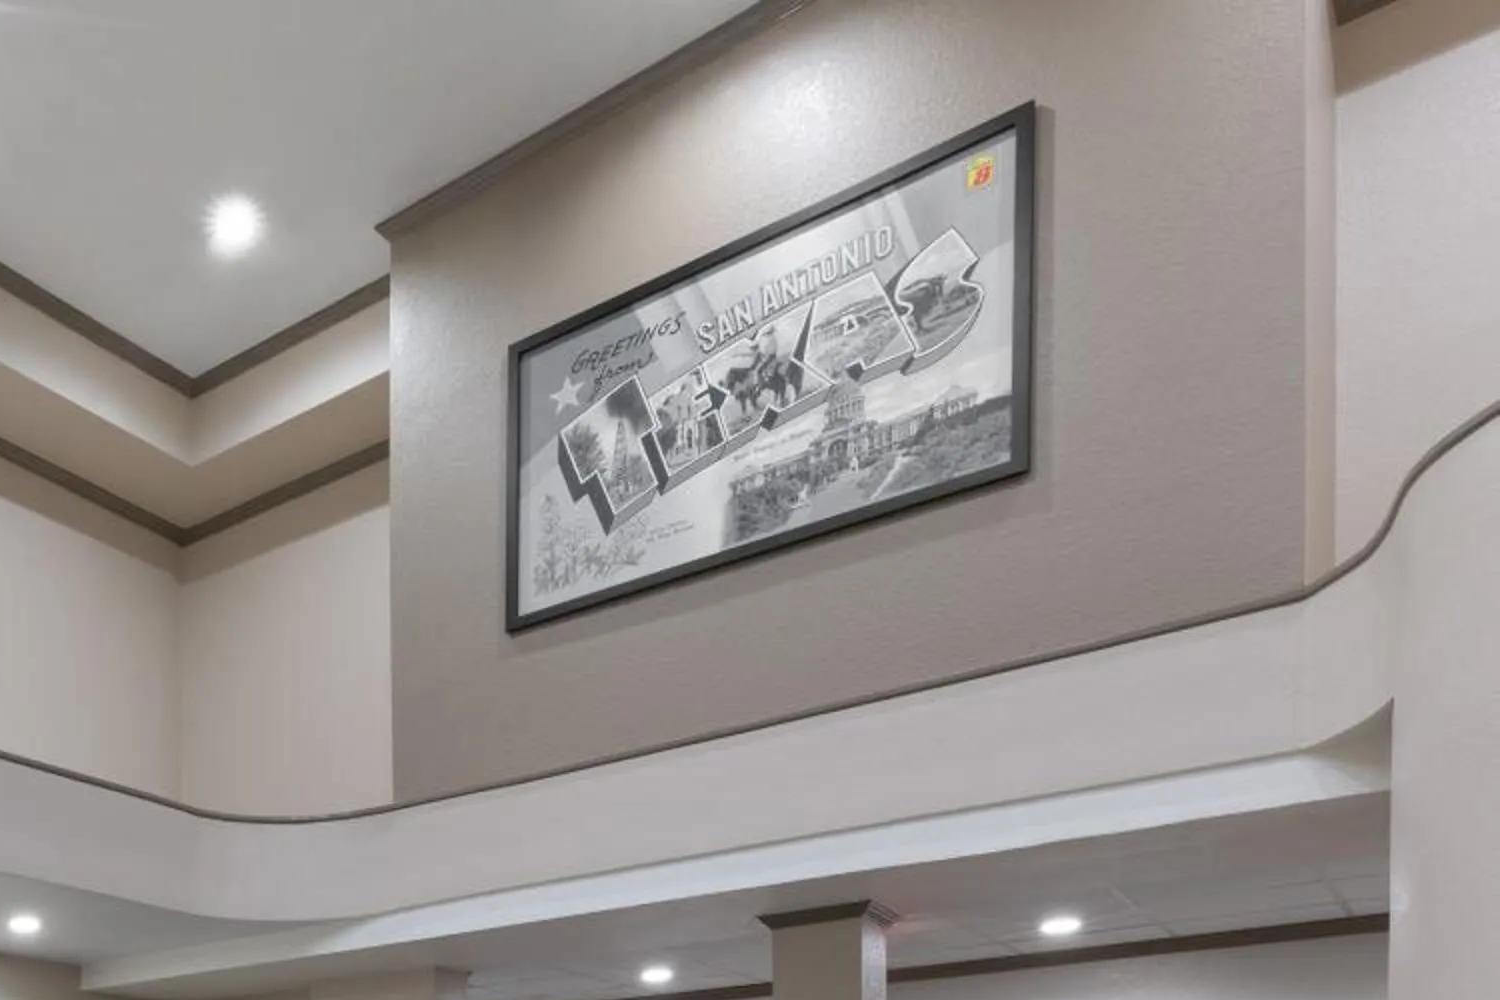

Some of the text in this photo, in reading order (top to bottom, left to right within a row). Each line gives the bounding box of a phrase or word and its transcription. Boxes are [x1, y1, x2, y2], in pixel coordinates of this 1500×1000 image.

[571, 310, 686, 374] GREETINGS
[696, 225, 894, 353] SAN ANTONIO
[558, 226, 985, 536] TEXAS
